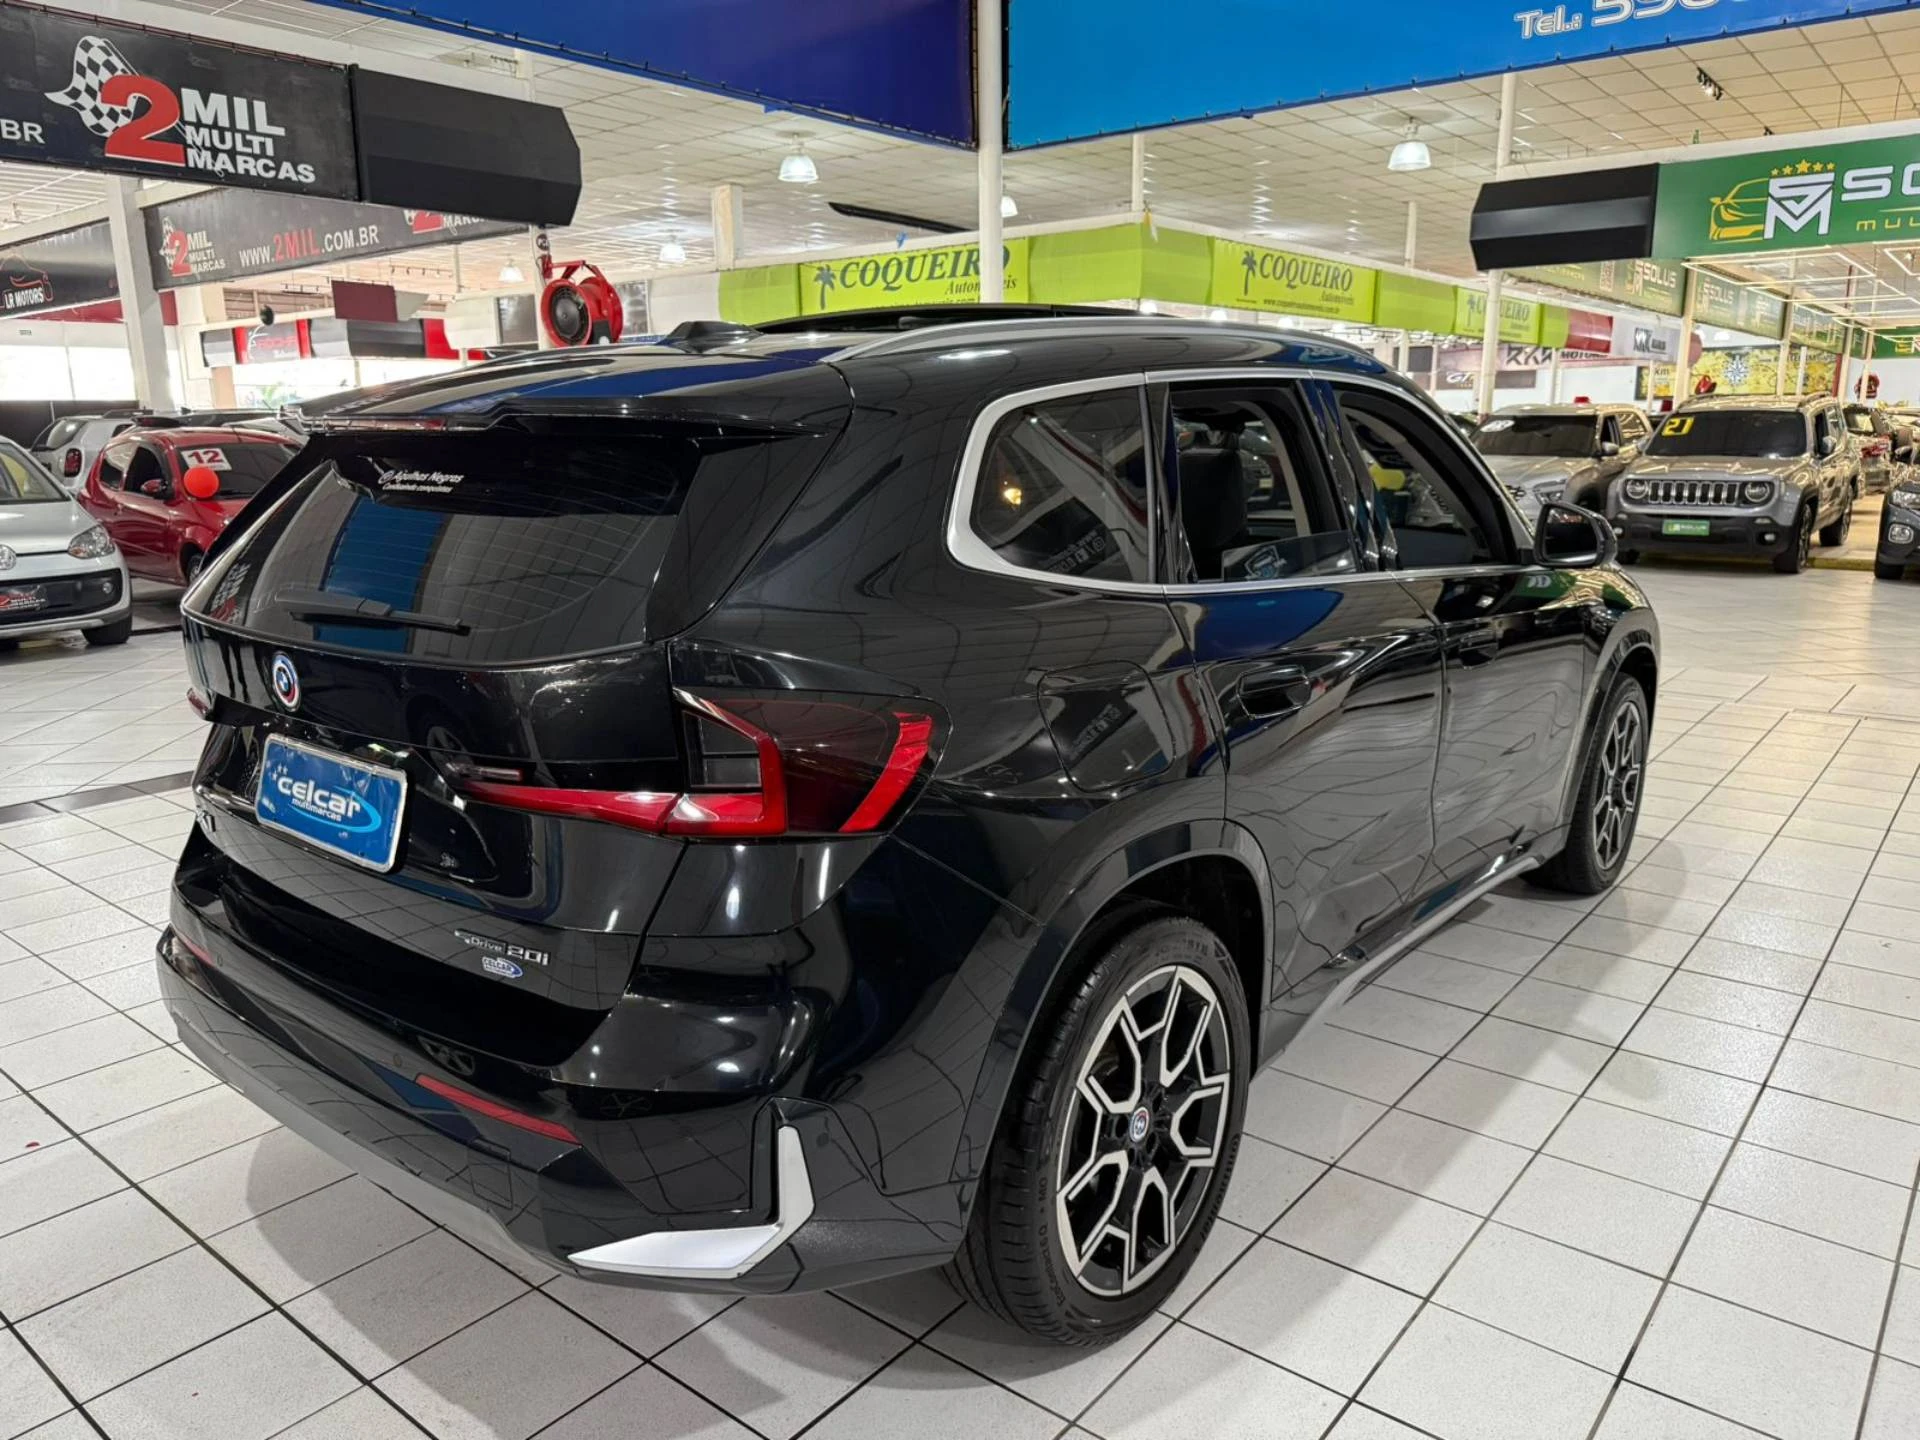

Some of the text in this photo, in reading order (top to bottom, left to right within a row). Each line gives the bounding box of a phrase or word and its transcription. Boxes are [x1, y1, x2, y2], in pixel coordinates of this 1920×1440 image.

[0, 118, 46, 144] BR
[100, 75, 286, 167] 2 MIL
[185, 125, 275, 157] MULTI
[187, 148, 316, 183] MARCAS
[187, 230, 213, 250] MIL
[239, 224, 380, 268] WWW.2MIL.COM.BR
[189, 248, 215, 262] MULTI
[191, 258, 226, 276] MARCAS
[839, 245, 1011, 292] COQUEIR
[945, 273, 1018, 295] Autois
[1260, 252, 1353, 292] COQUEIRO
[1643, 263, 1677, 288] SOLUS
[187, 450, 224, 464] 12
[277, 776, 361, 818] celcar
